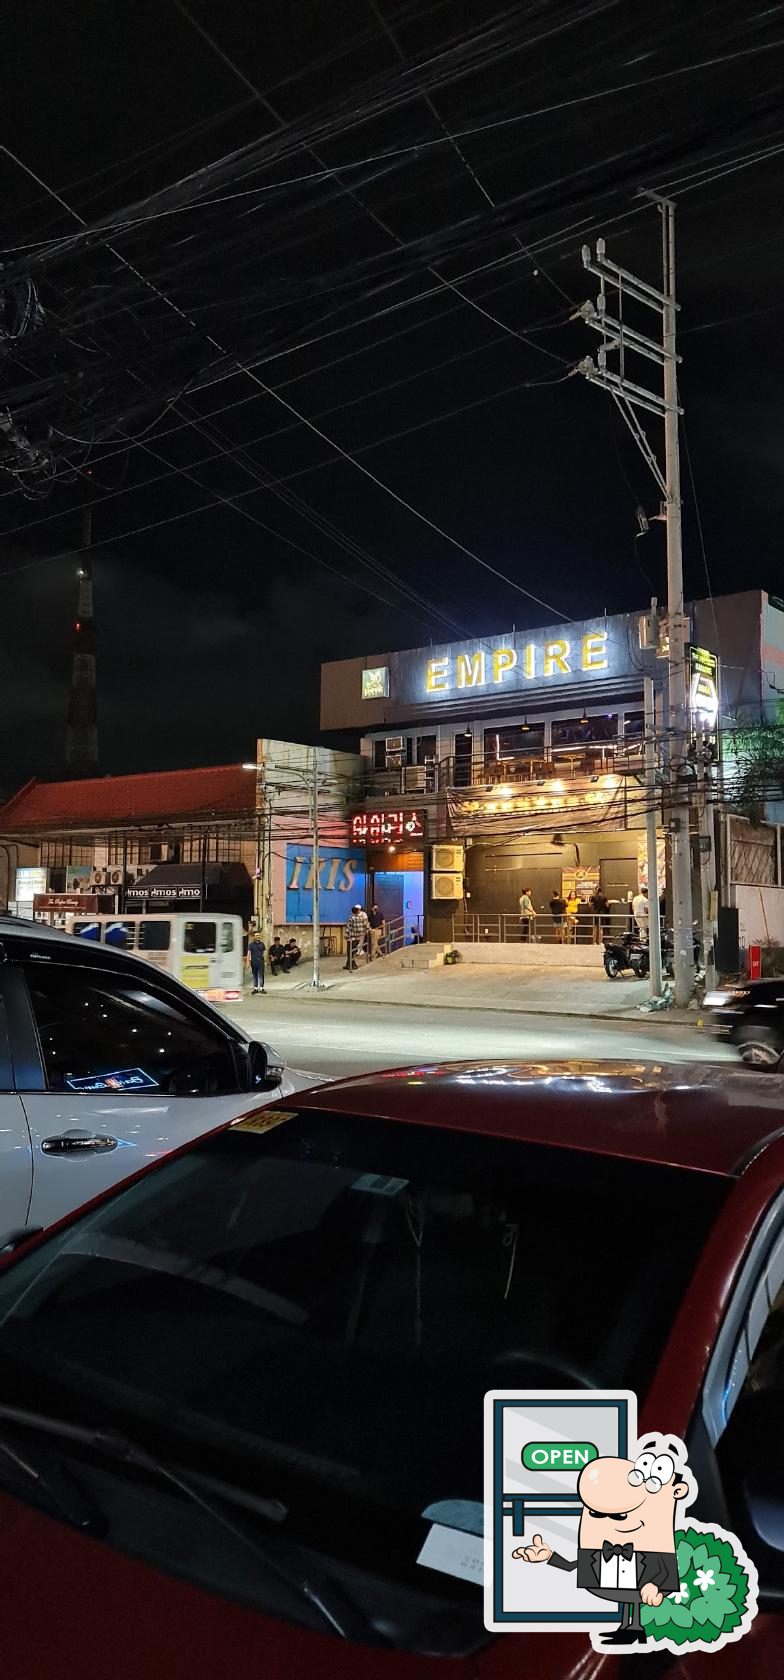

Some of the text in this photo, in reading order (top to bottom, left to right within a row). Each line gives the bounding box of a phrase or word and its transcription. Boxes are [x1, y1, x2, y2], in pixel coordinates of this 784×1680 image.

[425, 631, 608, 692] EMPIRE
[289, 856, 358, 891] IRIS
[178, 888, 201, 896] Amo
